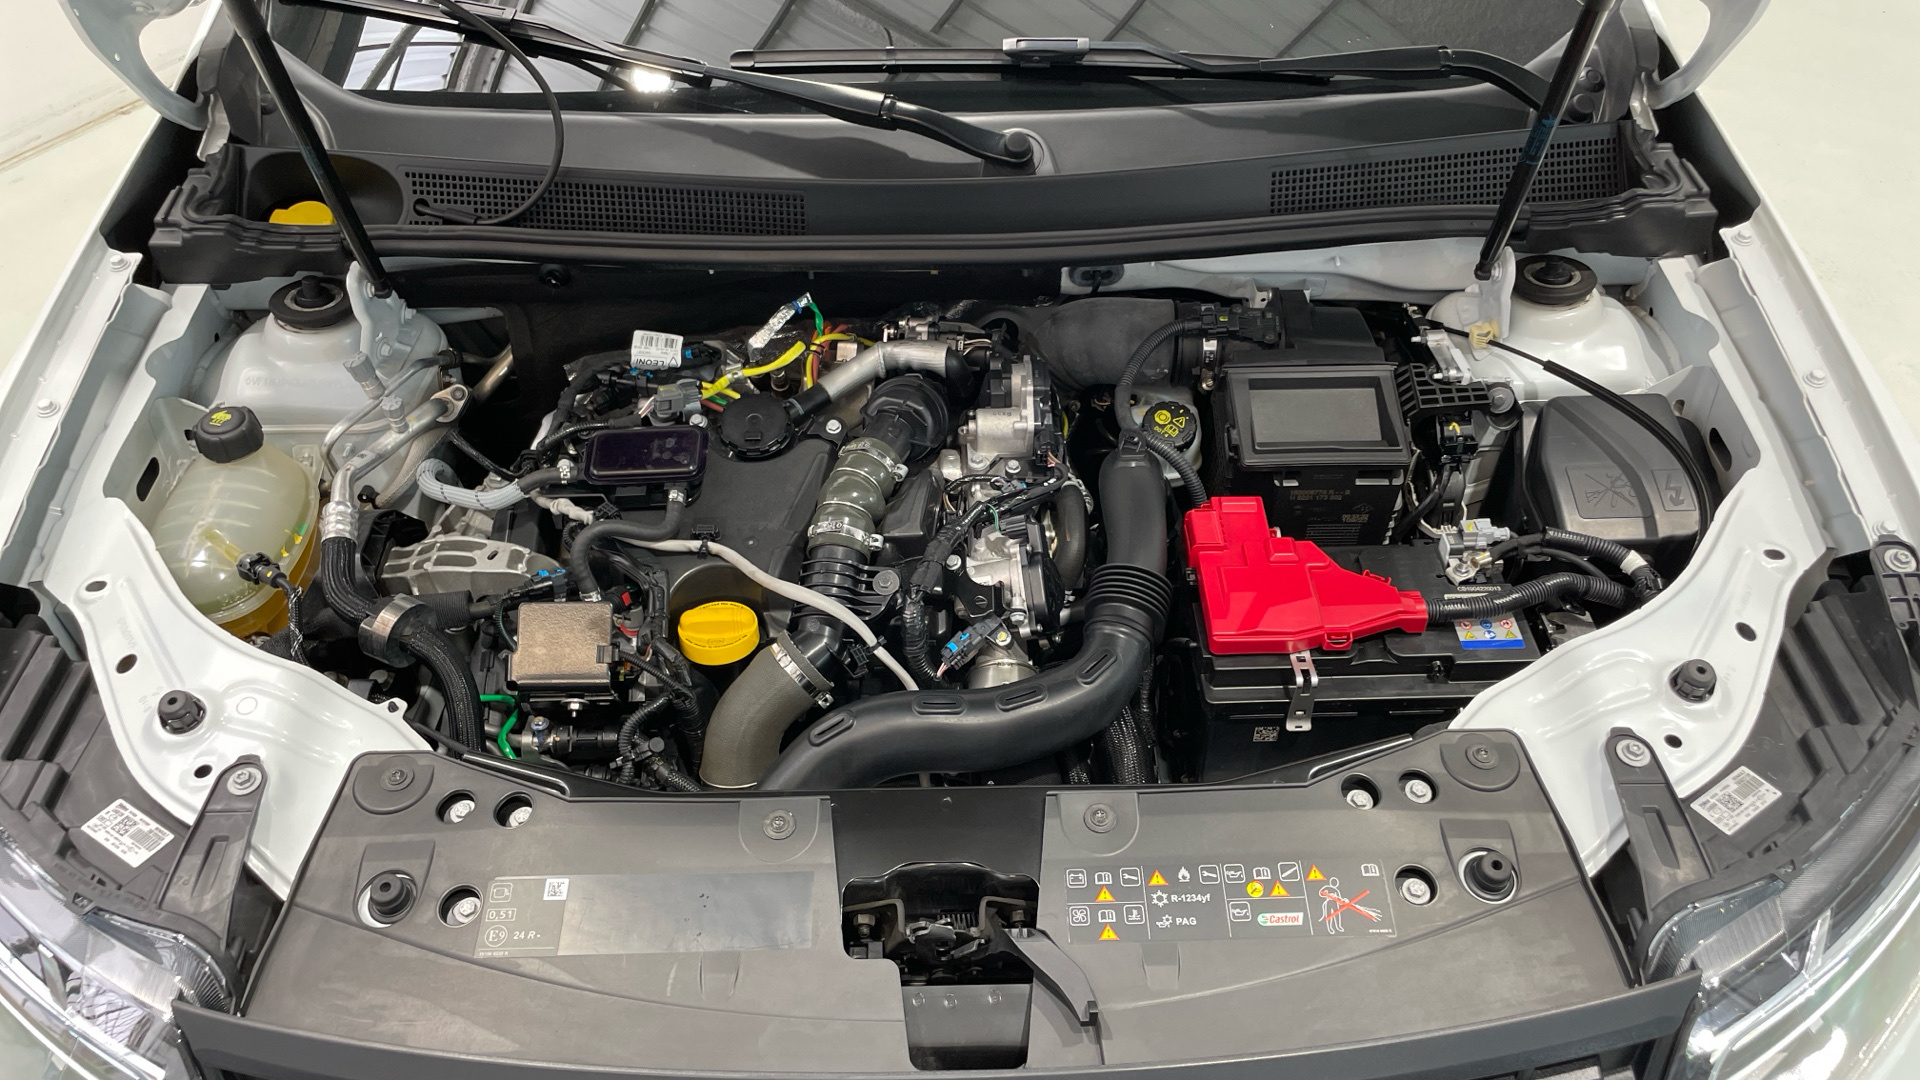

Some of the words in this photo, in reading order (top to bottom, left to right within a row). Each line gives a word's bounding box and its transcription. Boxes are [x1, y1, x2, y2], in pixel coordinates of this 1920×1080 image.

[635, 358, 665, 367] LEONI
[1170, 893, 1211, 904] R-1234yf
[489, 910, 513, 920] 0,51
[1269, 914, 1300, 924] Castrol
[1176, 917, 1197, 926] PAG
[488, 929, 506, 942] E9
[513, 931, 525, 940] 24
